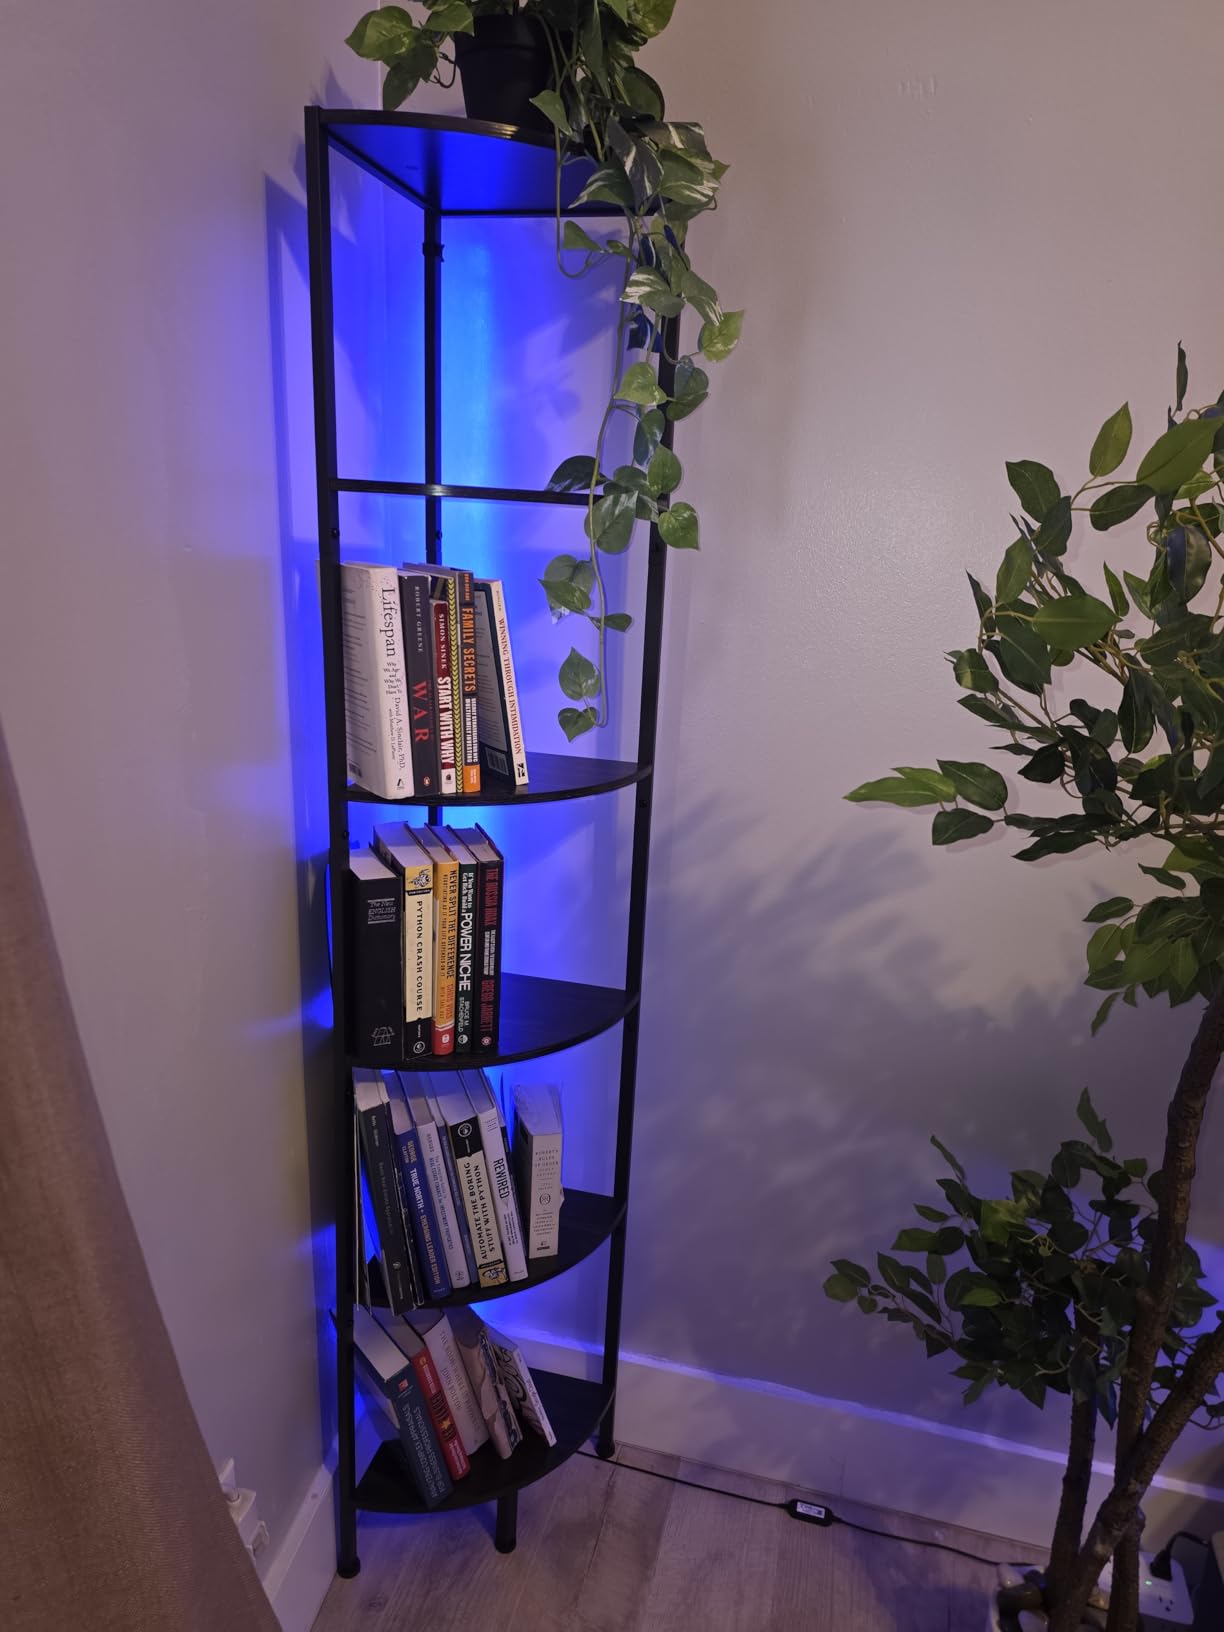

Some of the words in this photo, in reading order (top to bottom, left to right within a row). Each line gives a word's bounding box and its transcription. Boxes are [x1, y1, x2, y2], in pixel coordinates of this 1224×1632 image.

[379, 587, 400, 657] Lifespan
[460, 607, 474, 643] FAMILY
[498, 618, 509, 655] WINNING
[463, 647, 477, 691] SECRETS
[503, 658, 514, 697] THROUGH
[437, 676, 452, 709] START
[438, 710, 454, 739] WITH
[508, 700, 521, 754] INTIMIDATION
[440, 739, 455, 763] WHY
[448, 870, 456, 893] NEVER
[448, 895, 456, 916] SPLIT
[447, 918, 455, 933] THE
[460, 912, 472, 951] POWER
[447, 935, 455, 978] DIFFERENCE
[458, 953, 471, 991] NICHE
[409, 1167, 419, 1185] TRUE
[463, 1162, 476, 1197] BORING
[473, 1164, 485, 1200] PYTHON
[492, 1158, 510, 1199] REWIRED
[413, 1185, 424, 1208] NORTH
[470, 1198, 479, 1215] THE
[419, 1214, 431, 1242] EMERGING
[479, 1202, 490, 1225] WITH
[425, 1241, 436, 1263] LEADER
[473, 1216, 487, 1260] AUTOMATE
[484, 1227, 495, 1252] STUFF
[430, 1263, 440, 1284] EDITION
